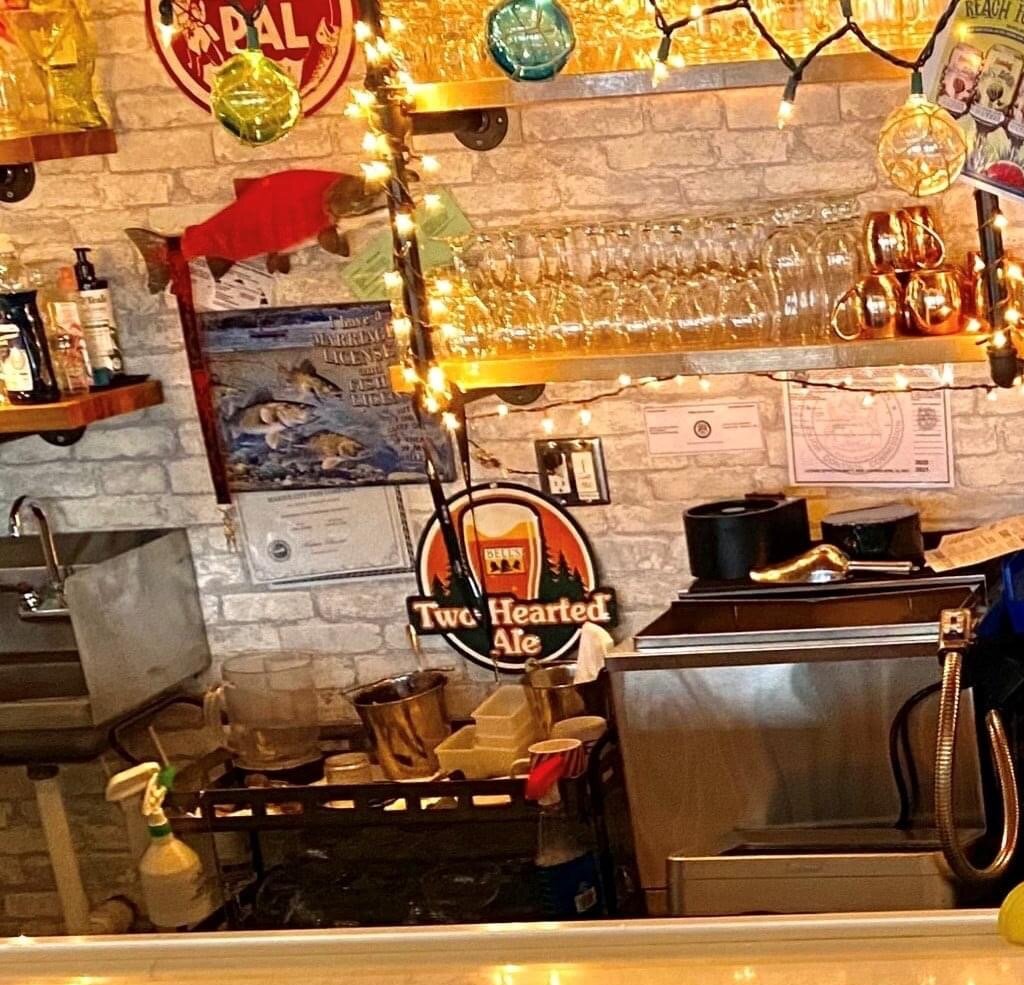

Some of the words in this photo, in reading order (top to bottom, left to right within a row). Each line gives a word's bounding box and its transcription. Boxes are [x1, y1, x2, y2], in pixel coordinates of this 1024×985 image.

[413, 601, 482, 630] Two
[488, 592, 612, 625] Hearted
[493, 627, 543, 655] Ale
